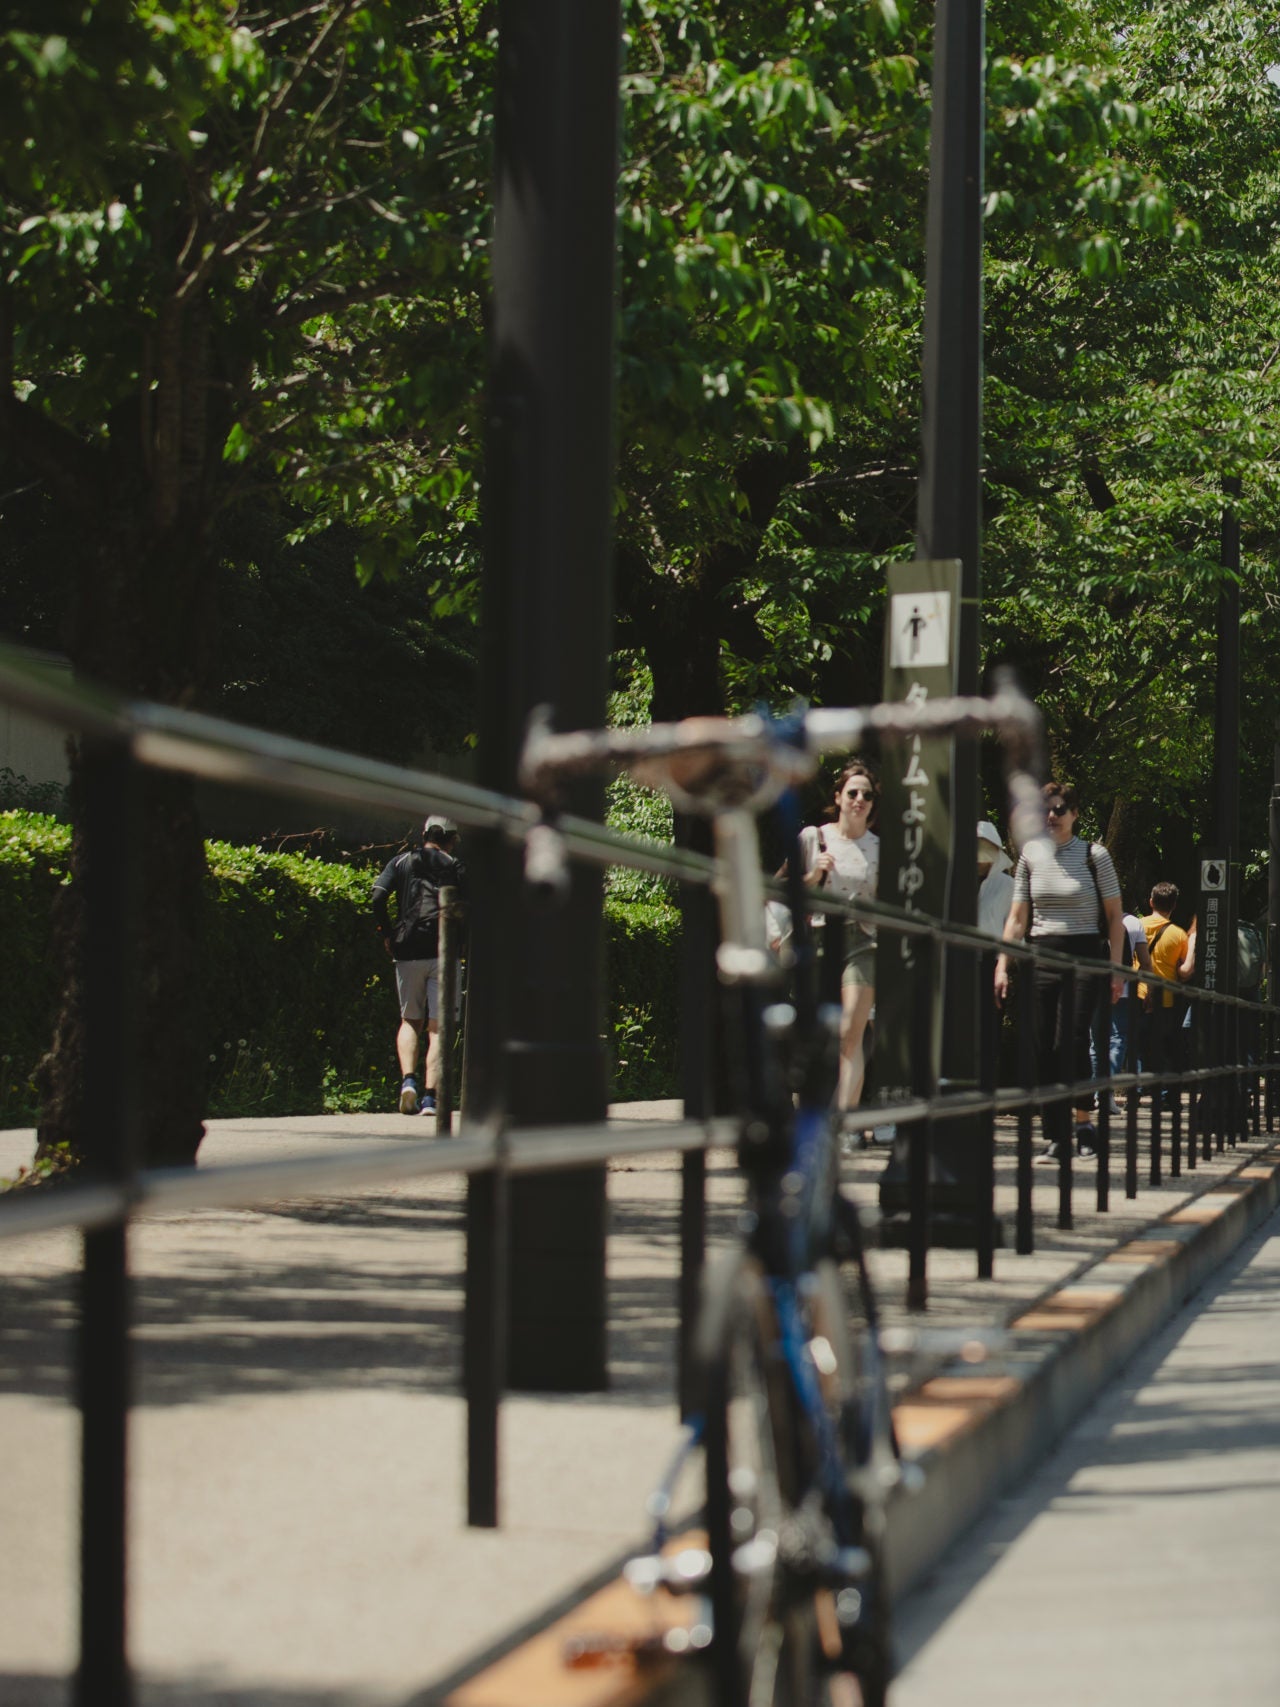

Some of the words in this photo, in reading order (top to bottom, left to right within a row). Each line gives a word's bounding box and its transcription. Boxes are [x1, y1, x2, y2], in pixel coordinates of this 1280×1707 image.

[1204, 897, 1219, 1016] 周回は反時計
